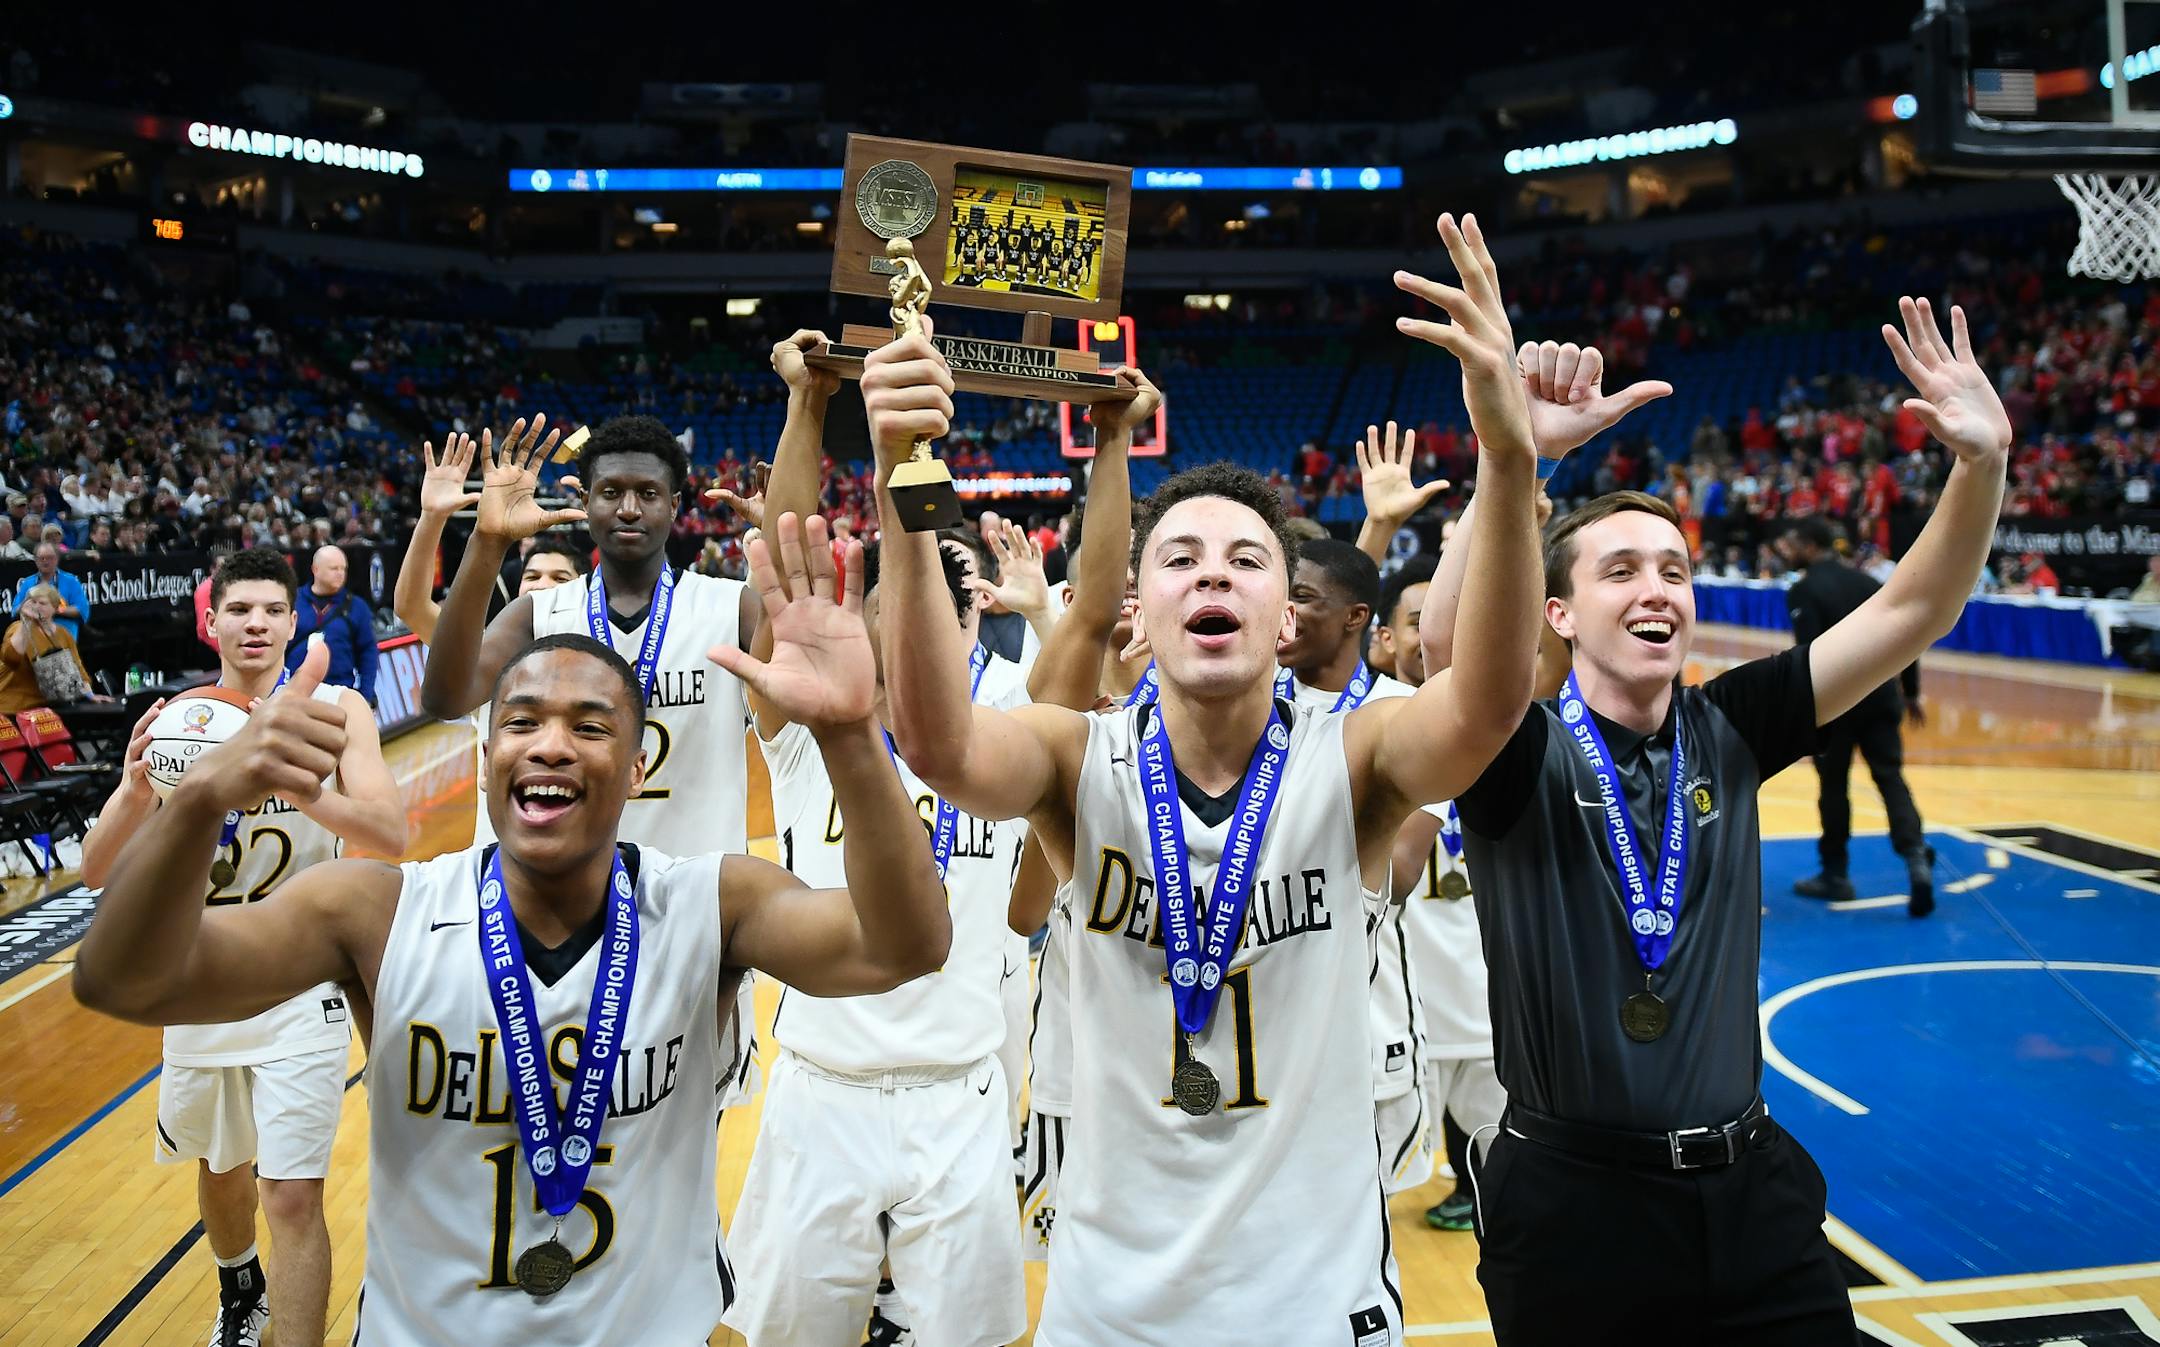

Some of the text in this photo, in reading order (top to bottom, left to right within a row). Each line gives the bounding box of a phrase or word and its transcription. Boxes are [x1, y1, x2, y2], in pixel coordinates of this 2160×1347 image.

[188, 121, 423, 178] CHAMPIONSHIPS
[943, 338, 1057, 369] BASKETBALL
[964, 360, 998, 373] AAA
[998, 363, 1079, 382] CHAMPION
[100, 569, 149, 605] School
[149, 567, 192, 607] League
[644, 584, 672, 661] CHAMPIONSHIPS
[935, 817, 954, 858] STATE
[1145, 742, 1190, 952] STATE CHAMPIONSHIPS
[1573, 723, 1646, 905] STATE CHAMPIONSHIPS
[204, 824, 293, 907] 22
[1207, 751, 1280, 957] STATE CHAMPIONSHIPS
[1660, 856, 1680, 908] STATE
[330, 999, 339, 1009] L
[486, 911, 550, 1142] STATE CHAMPIONSHIPS
[574, 900, 632, 1130] STATE CHAMPIONSHIPS
[1159, 964, 1271, 1112] 11
[477, 1142, 617, 1292] 15
[1364, 1314, 1377, 1330] L
